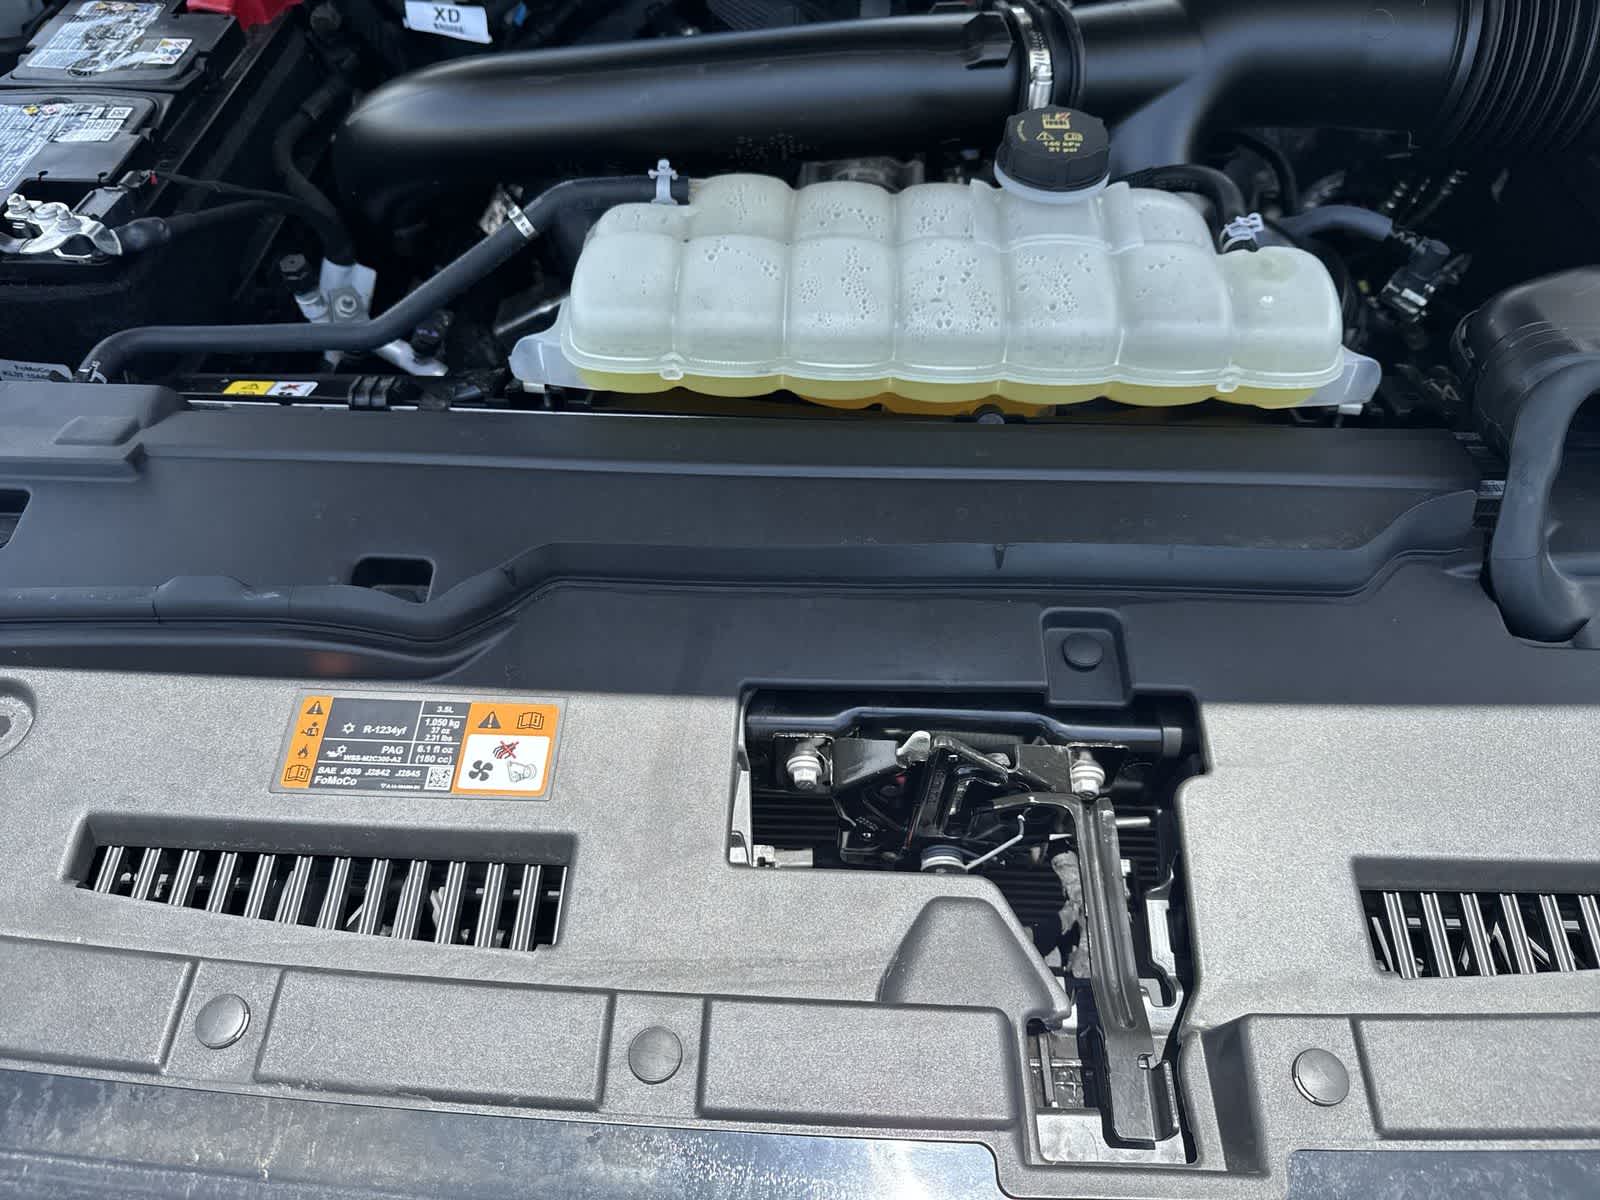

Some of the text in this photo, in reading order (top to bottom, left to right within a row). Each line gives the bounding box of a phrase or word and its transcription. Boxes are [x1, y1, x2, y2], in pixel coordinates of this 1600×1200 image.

[433, 6, 461, 24] XD
[424, 717, 461, 729] 1.050 kg
[362, 724, 407, 736] R-1234yf
[431, 726, 441, 734] 37
[424, 734, 453, 742] 2.31 lbs
[380, 745, 404, 755] PAG
[416, 744, 431, 753] 6.1
[432, 745, 441, 753] fl
[436, 756, 453, 765] cc)
[317, 766, 422, 778] SAE J639 J2842 J2845
[313, 775, 358, 786] FoMoCo
